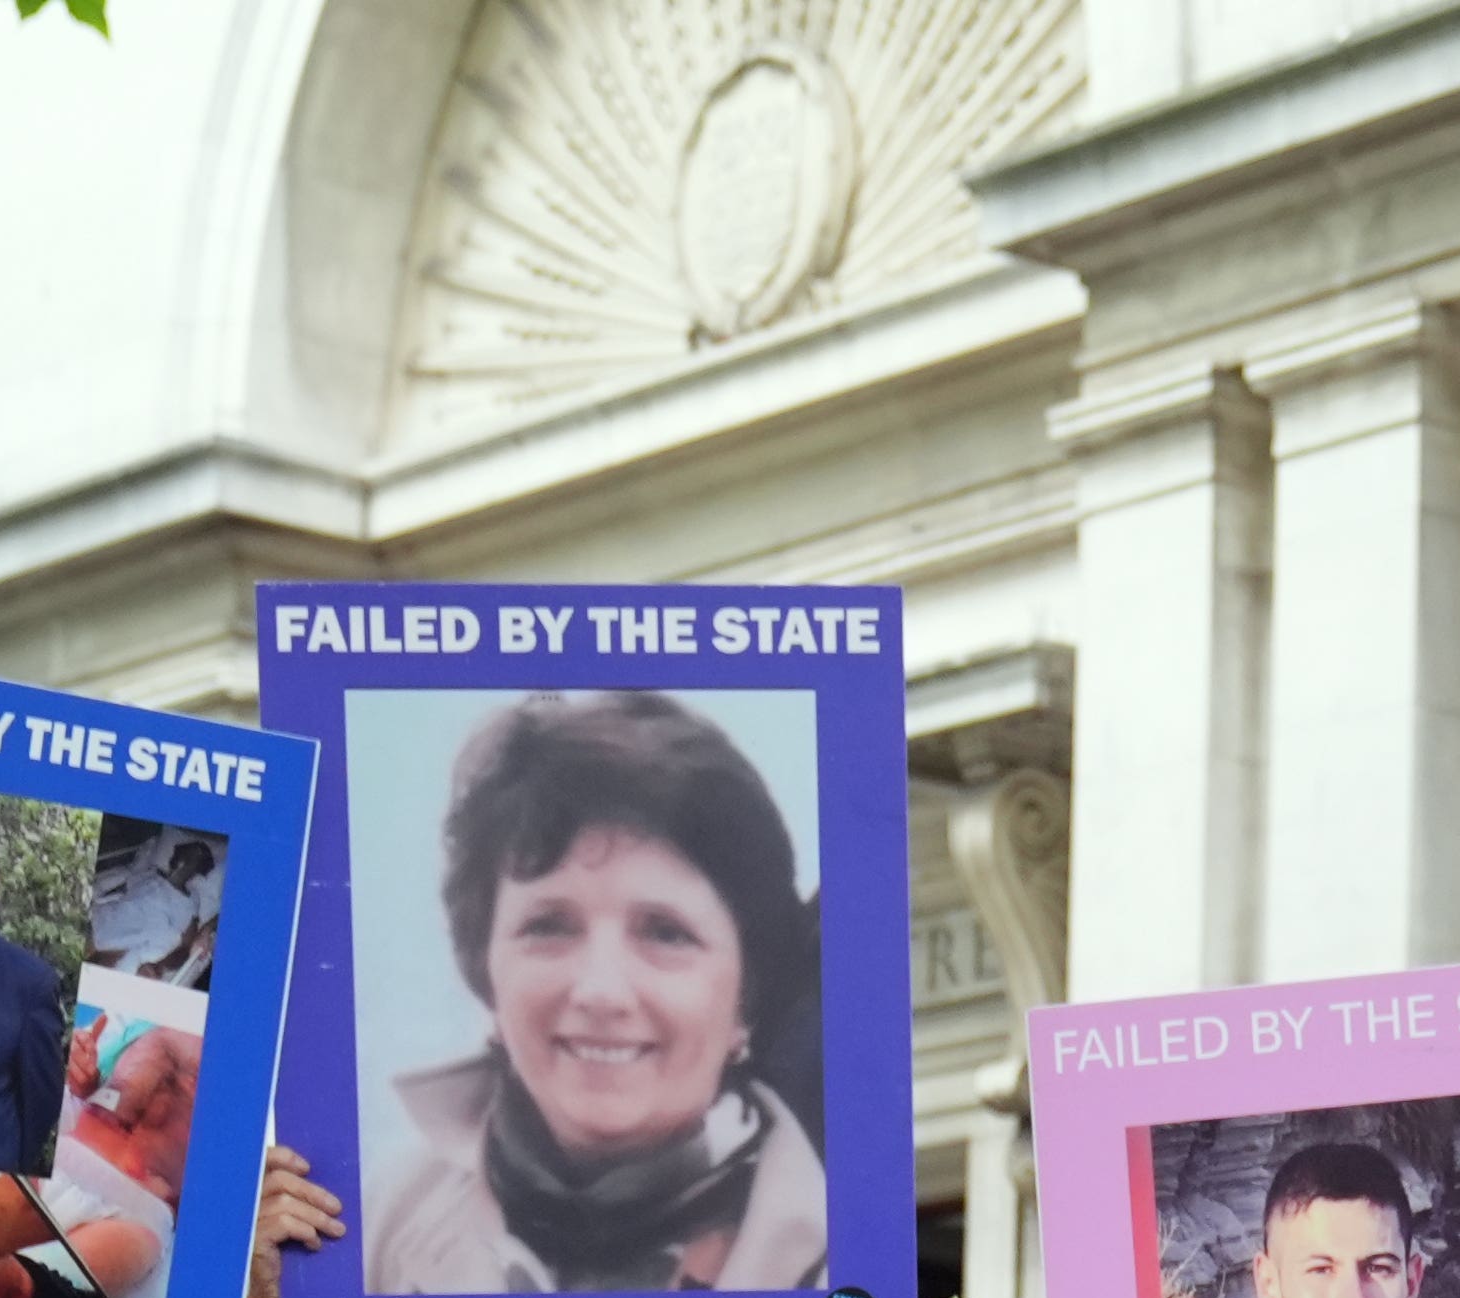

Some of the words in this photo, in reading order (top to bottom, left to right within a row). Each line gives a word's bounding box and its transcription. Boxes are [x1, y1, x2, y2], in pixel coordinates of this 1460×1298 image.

[275, 605, 481, 653] FAILED
[498, 606, 574, 654] BY
[586, 606, 698, 654] THE
[711, 606, 881, 655] STATE
[1053, 1015, 1229, 1074] FAILED
[1250, 1006, 1313, 1055] BY
[1328, 993, 1437, 1046] THE
